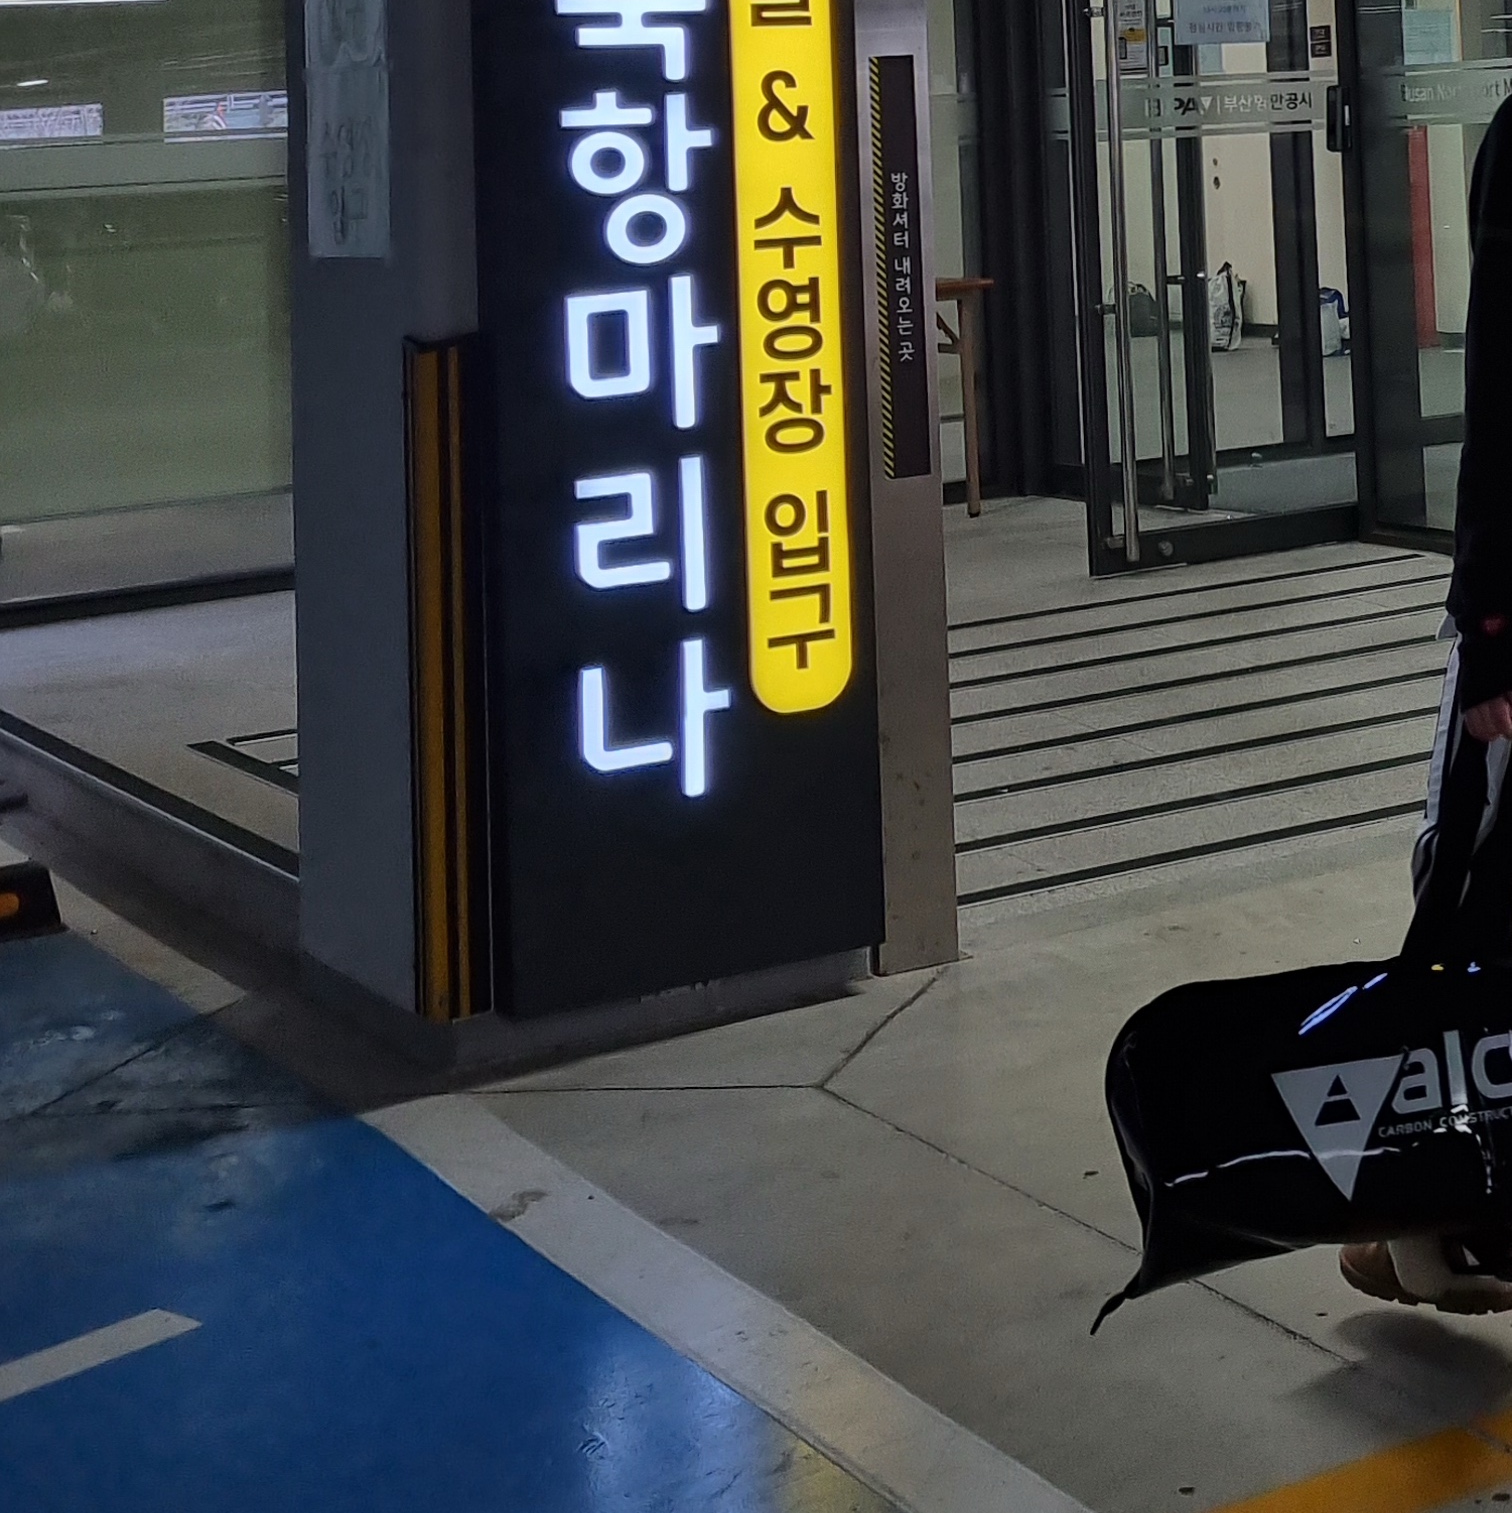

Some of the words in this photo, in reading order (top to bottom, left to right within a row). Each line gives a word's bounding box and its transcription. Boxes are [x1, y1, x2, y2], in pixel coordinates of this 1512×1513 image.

[756, 69, 815, 142] &
[890, 171, 910, 249] 방화셔터
[753, 187, 833, 454] 수영장
[893, 255, 914, 337] 내려오는
[896, 340, 916, 363] 곳
[763, 489, 836, 670] 입구
[1377, 1119, 1433, 1139] CARBON
